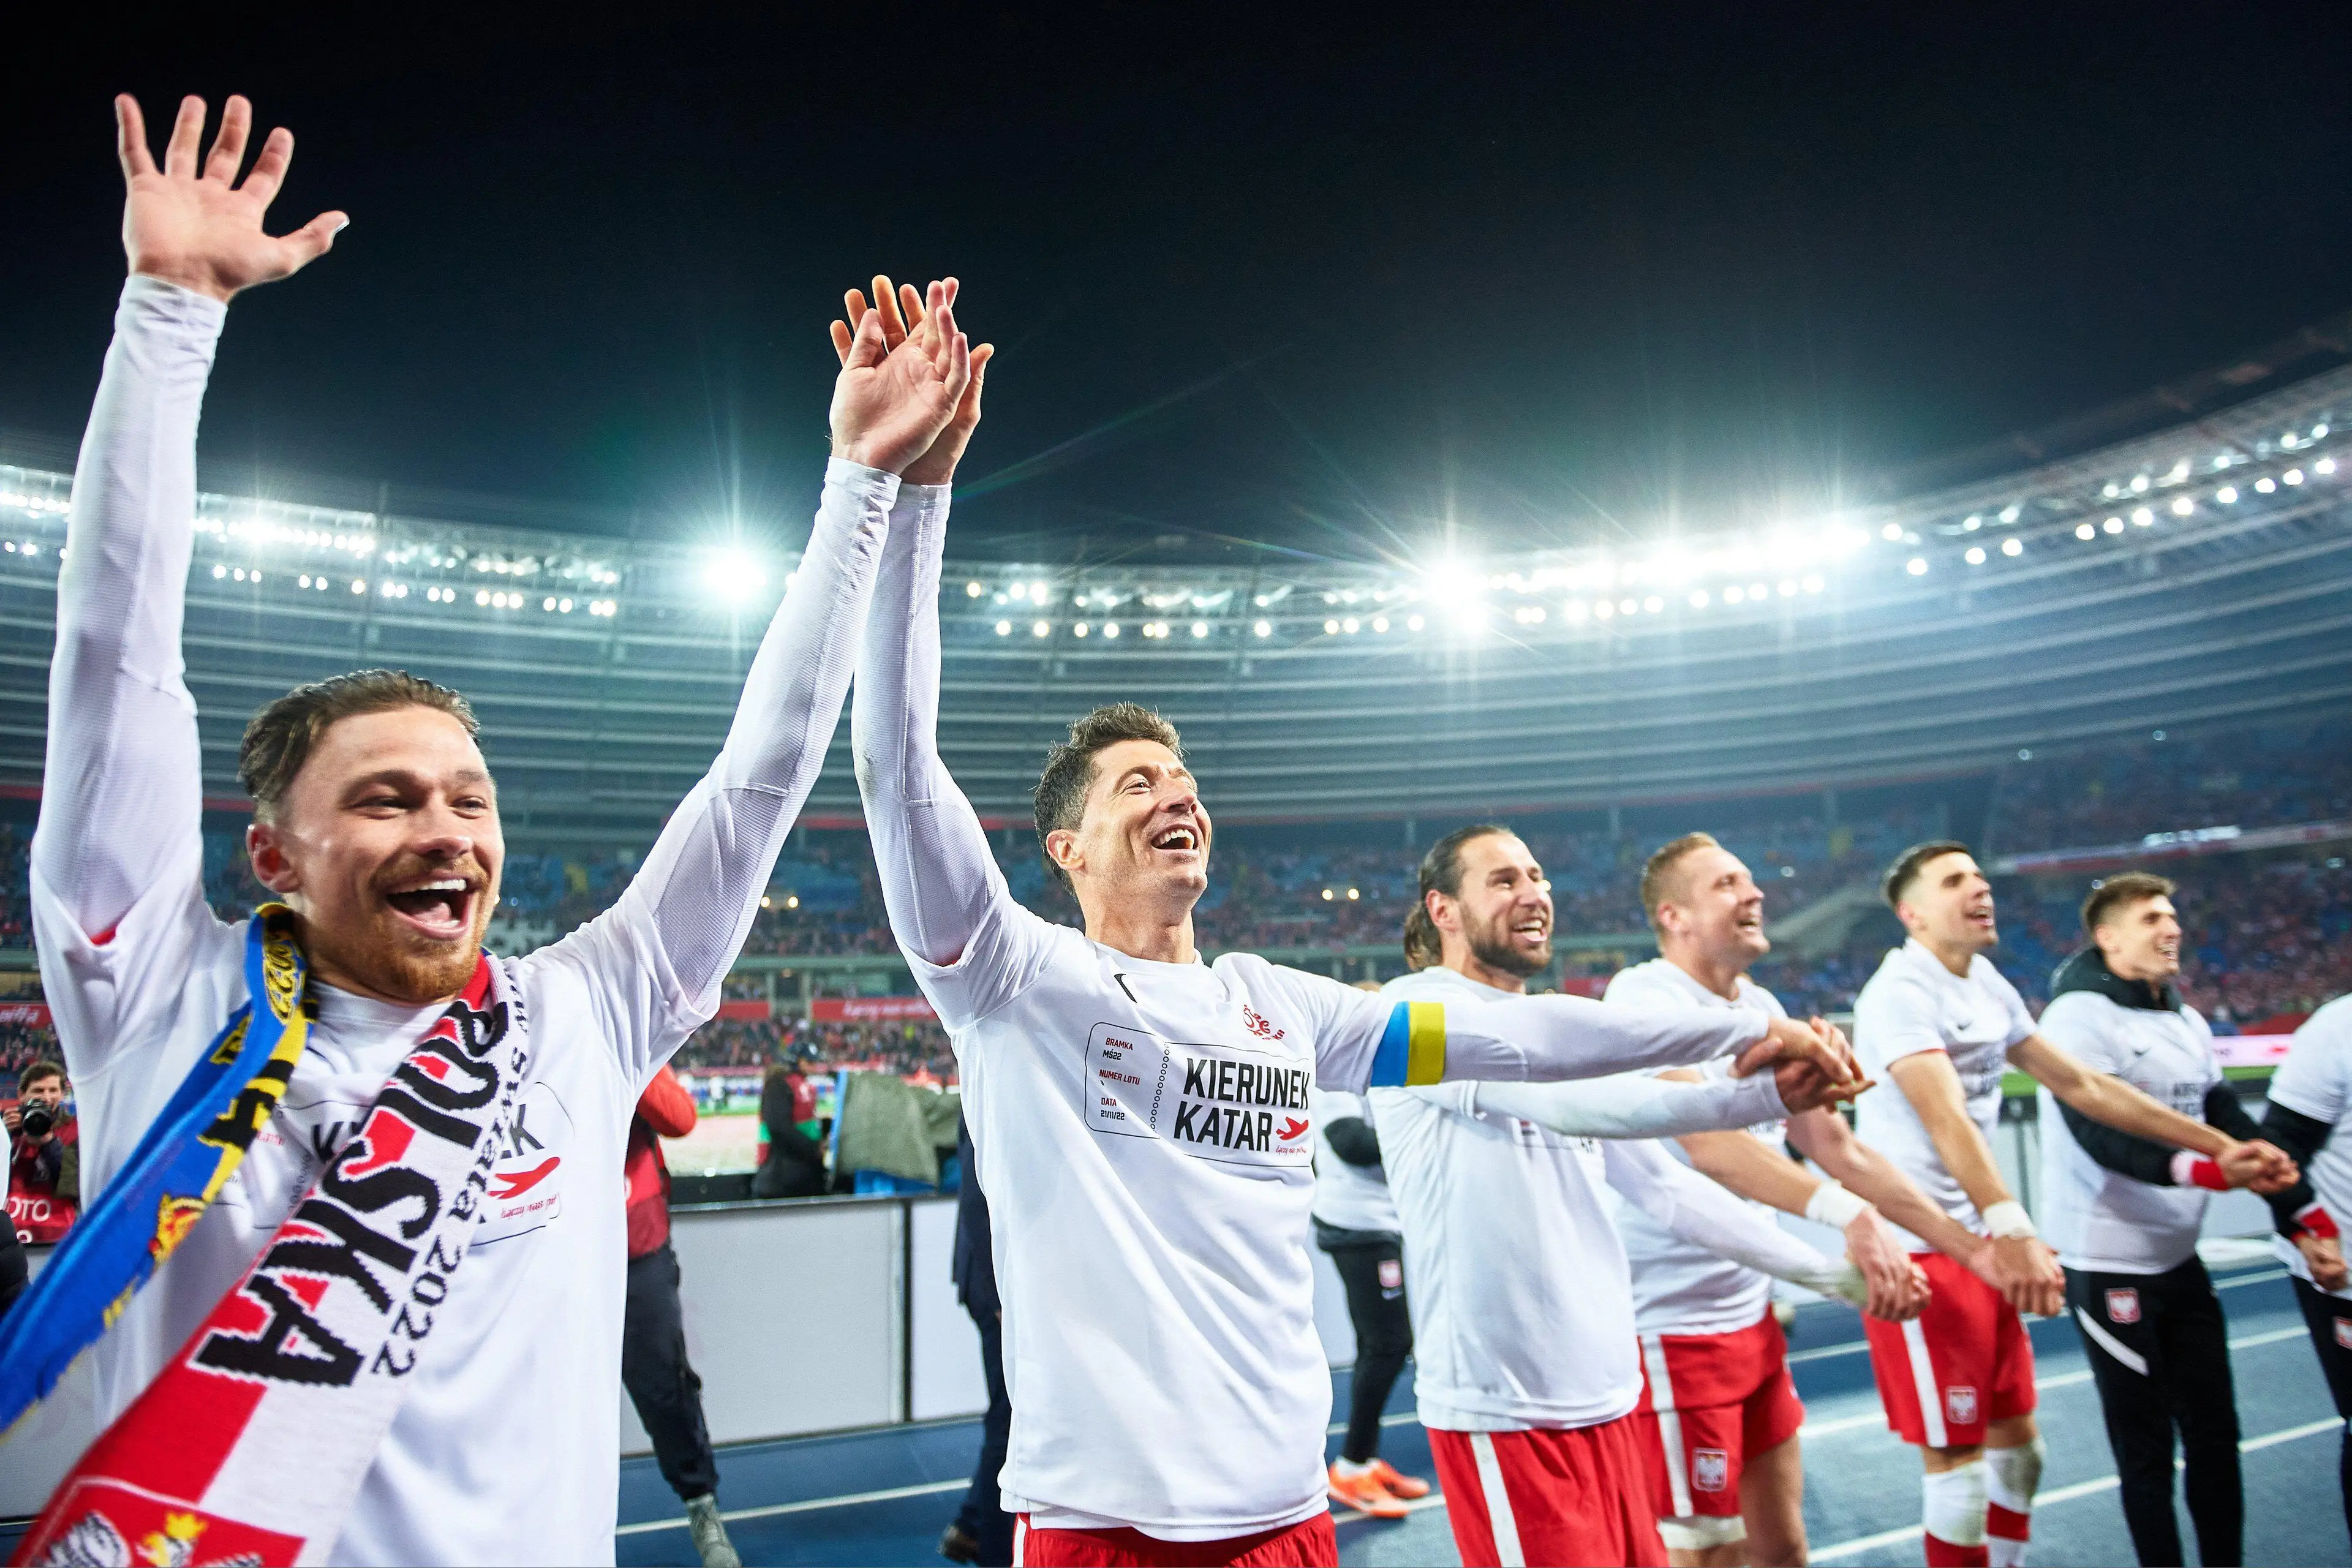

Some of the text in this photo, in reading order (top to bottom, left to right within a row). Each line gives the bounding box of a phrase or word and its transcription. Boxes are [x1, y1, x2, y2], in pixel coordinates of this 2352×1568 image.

[1106, 1037, 1133, 1050] BRAMKA
[1102, 1049, 1122, 1060] MŚ22
[1099, 1069, 1140, 1085] NUMER LOTU
[1183, 1057, 1310, 1110] KIERUNEK
[1101, 1097, 1117, 1107] DATA
[1101, 1110, 1125, 1121] 21/11/22
[1173, 1101, 1273, 1152] KATAR
[196, 1000, 510, 1387] POLSKA
[5, 1196, 51, 1222] OTO
[372, 1235, 461, 1377] 2022
